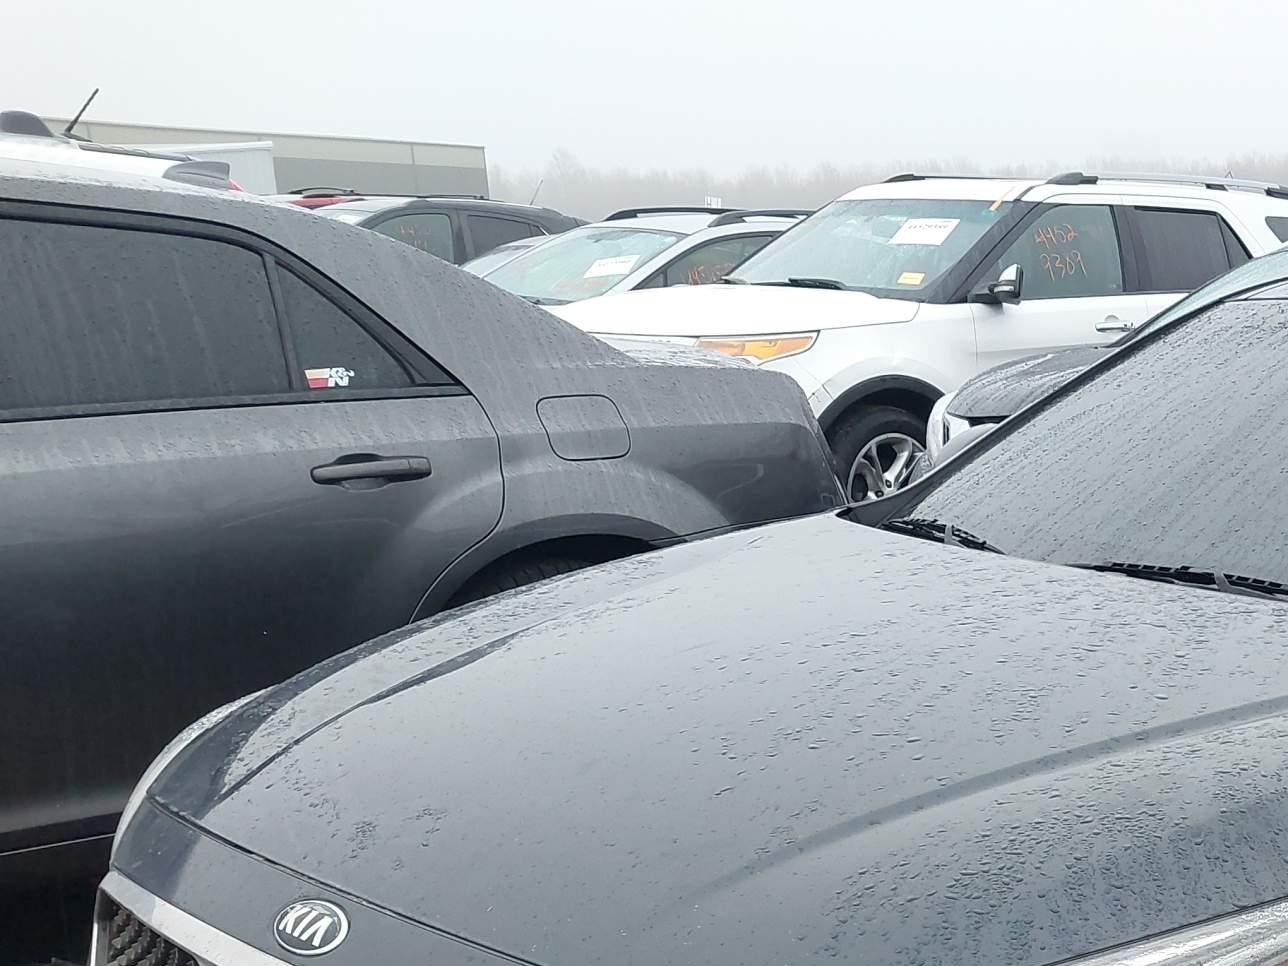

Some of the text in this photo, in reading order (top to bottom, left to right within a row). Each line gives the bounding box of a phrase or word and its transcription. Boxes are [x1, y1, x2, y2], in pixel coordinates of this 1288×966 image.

[1034, 223, 1079, 249] 4452
[1039, 249, 1089, 282] 9309
[277, 903, 334, 948] KIA
